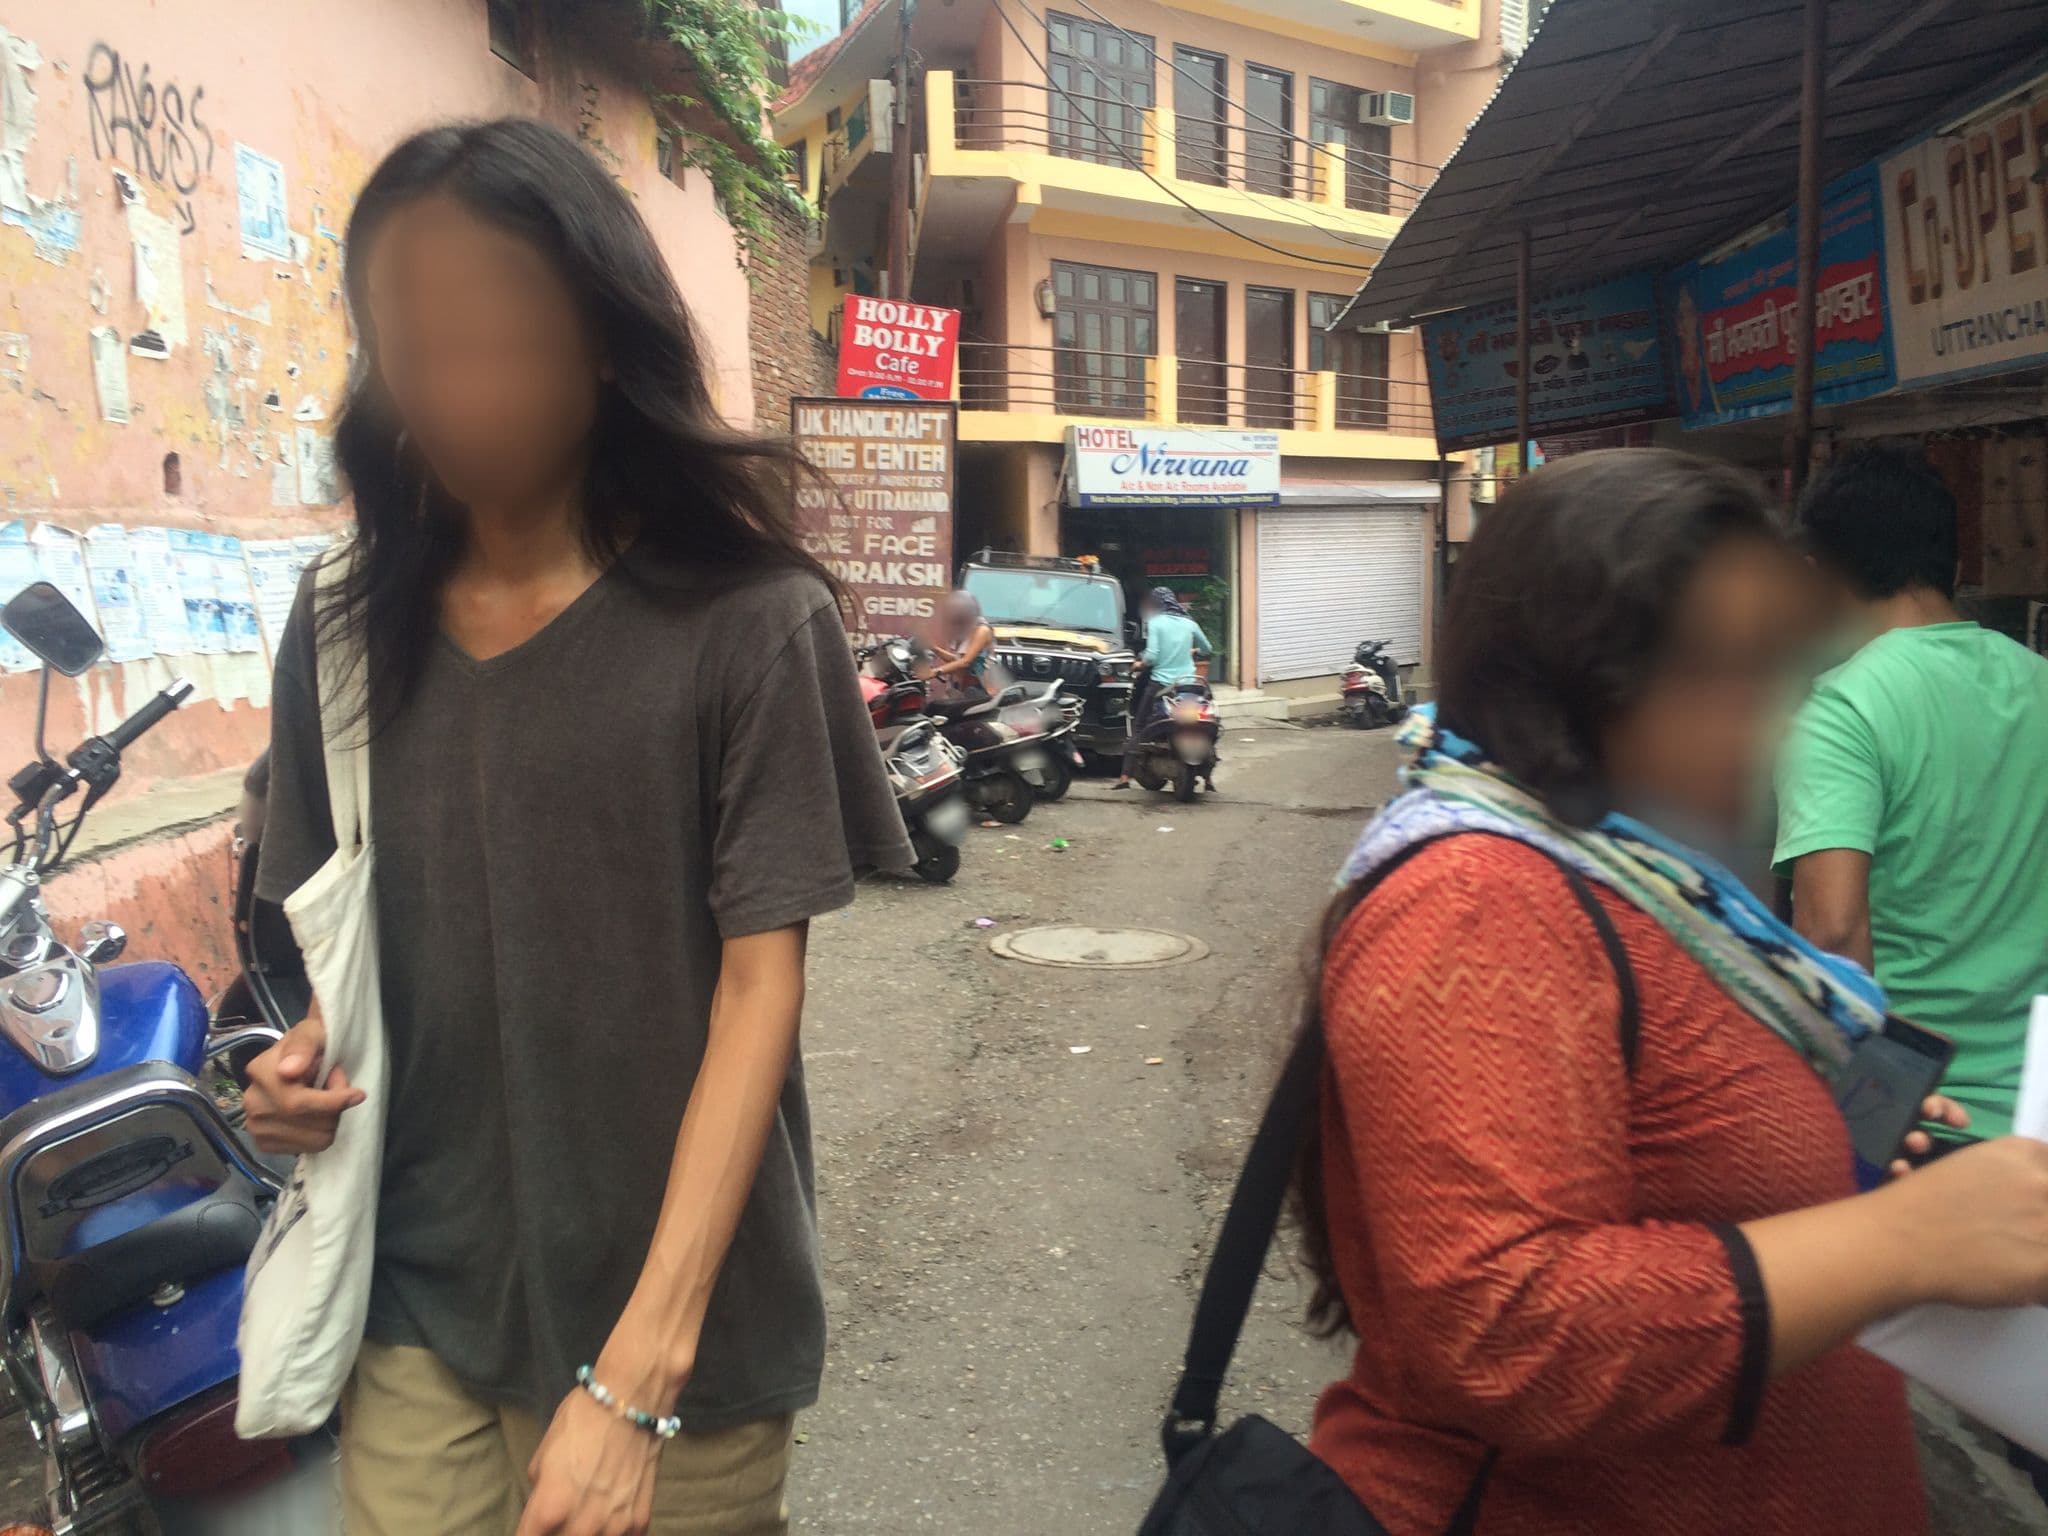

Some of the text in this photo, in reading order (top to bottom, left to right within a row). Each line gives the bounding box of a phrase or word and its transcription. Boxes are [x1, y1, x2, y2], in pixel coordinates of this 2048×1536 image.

[856, 299, 950, 332] HOLLY
[853, 324, 945, 357] BOLLY
[875, 352, 919, 374] Cafe
[829, 409, 949, 440] HANDICRAFT
[1078, 428, 1138, 449] HOTEL
[863, 443, 947, 472] CENTER
[866, 516, 894, 530] FOR
[864, 534, 936, 556] FACE
[863, 596, 936, 618] GEMS
